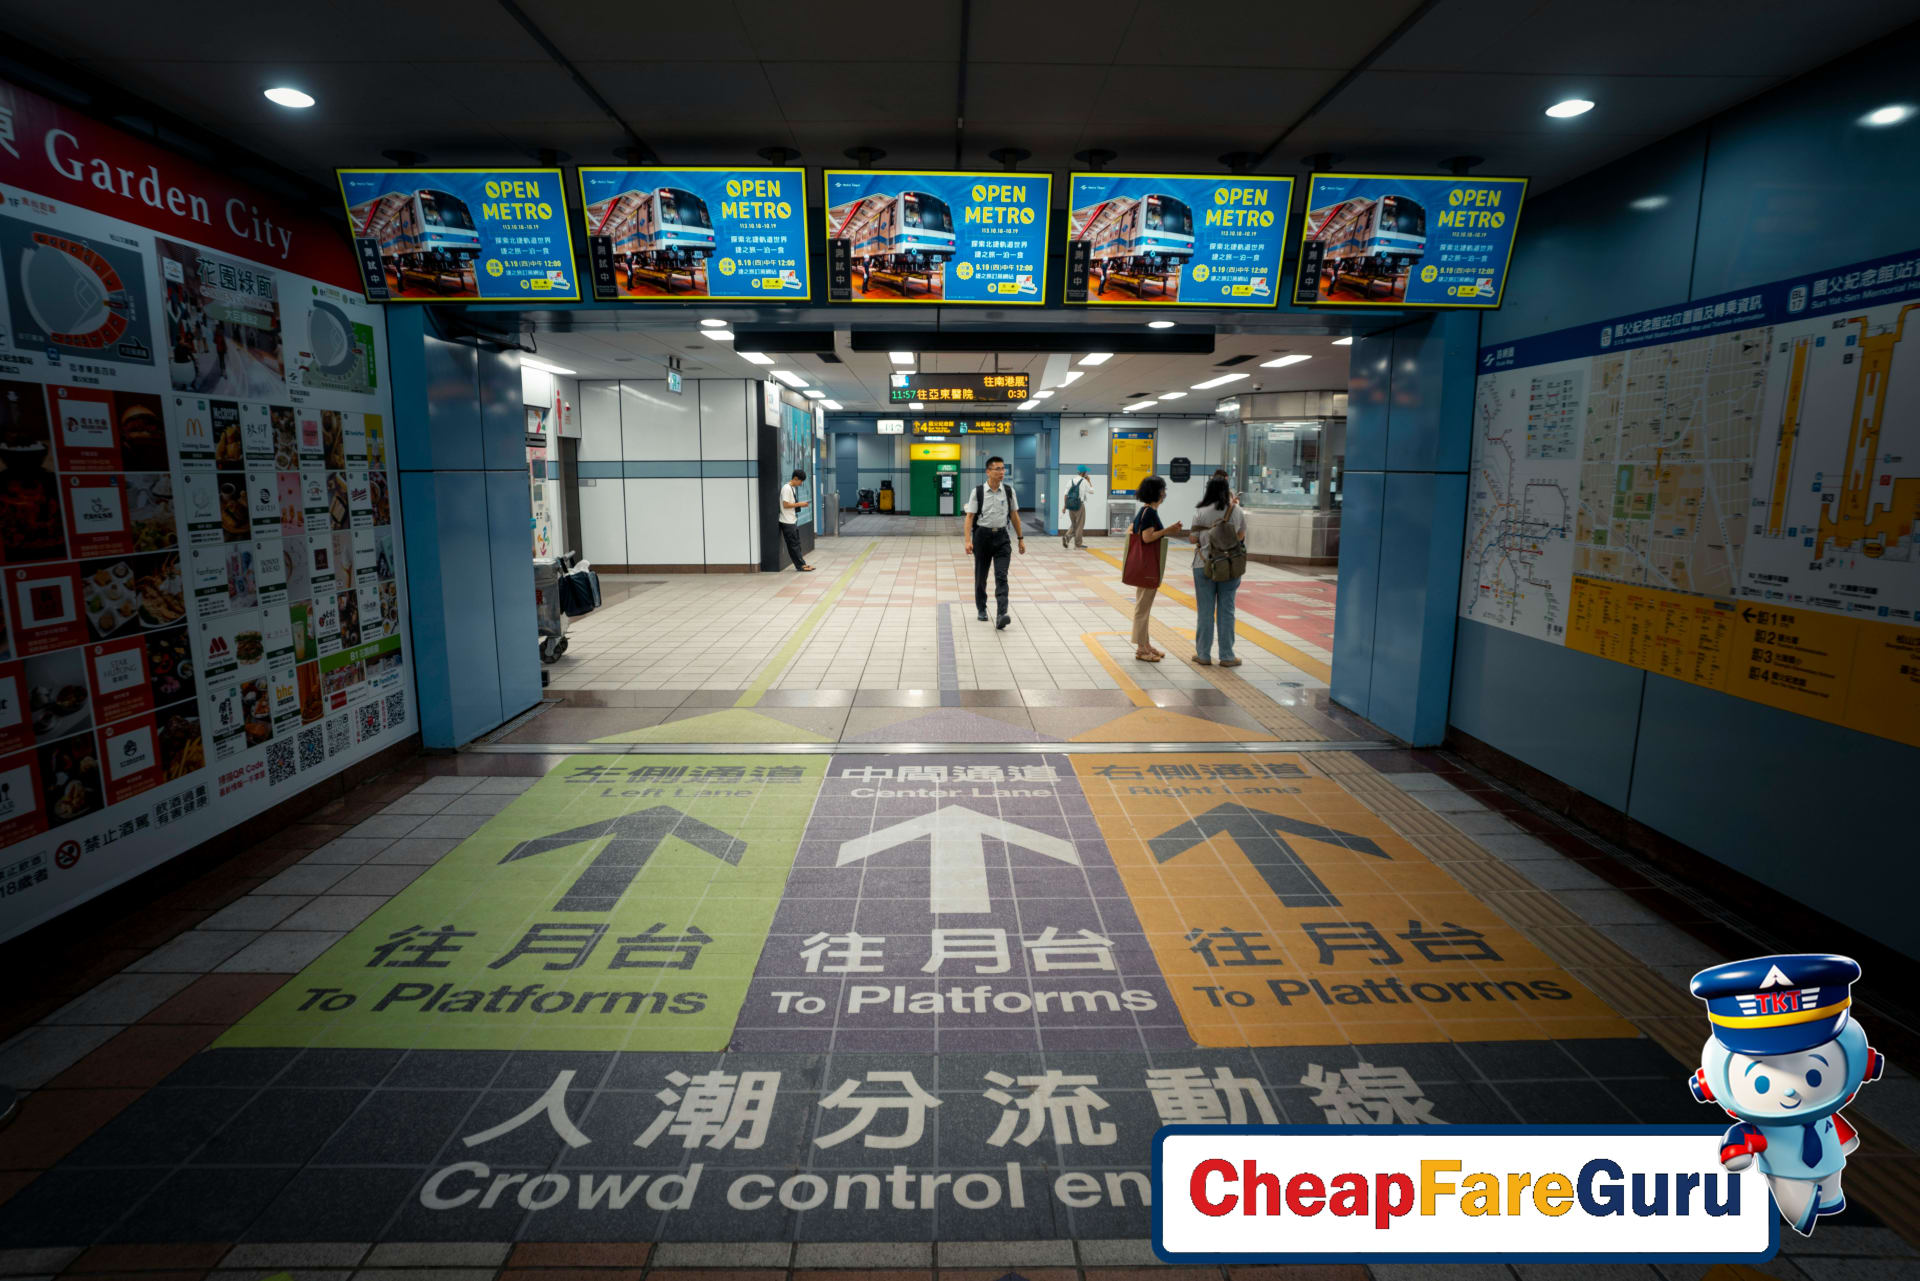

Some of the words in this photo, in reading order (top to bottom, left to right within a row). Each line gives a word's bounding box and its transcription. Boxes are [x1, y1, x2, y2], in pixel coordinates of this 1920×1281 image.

[44, 128, 213, 226] Garden
[225, 198, 293, 260] City
[485, 181, 540, 198] OPEN
[726, 180, 780, 197] OPEN
[972, 185, 1026, 203] OPEN
[1215, 188, 1268, 206] OPEN
[1448, 189, 1502, 207] OPEN
[482, 203, 552, 220] METRO
[721, 202, 792, 219] METRO
[965, 206, 1035, 224] METRO
[1205, 209, 1274, 227] METRO
[1437, 210, 1505, 228] METRO
[196, 258, 273, 300] 花園綠廊
[1811, 300, 1826, 309] Sun
[1862, 283, 1906, 299] Memorial
[984, 376, 1028, 388] 往南港展
[892, 390, 916, 399] 11:57
[917, 388, 974, 400] 往亞東醫院
[1008, 390, 1027, 399] 0:30
[920, 422, 928, 433] 4
[996, 422, 1004, 432] 3
[1771, 613, 1777, 625] 1
[1767, 632, 1776, 645] 2
[1764, 650, 1773, 664] 3
[1761, 669, 1769, 683] 4
[275, 685, 294, 700] bhc
[245, 761, 264, 773] Code
[564, 764, 808, 784] 左側通道
[841, 764, 1062, 785] 中間通道
[1092, 764, 1314, 784] 右側通道
[602, 787, 675, 798] Left
[686, 787, 753, 798] Lane
[850, 787, 961, 799] Center
[972, 787, 1055, 799] Lane
[1128, 786, 1219, 799] Right
[1230, 786, 1302, 798] Lane
[84, 813, 149, 853] 禁止酒駕
[365, 923, 713, 970] 往月台
[800, 927, 1117, 975] 往月台
[1190, 920, 1504, 968] 往月台
[297, 988, 356, 1012] To
[371, 983, 708, 1015] Platforms
[771, 991, 826, 1015] To
[847, 985, 1158, 1015] Platforms
[1192, 986, 1256, 1008] To
[1273, 977, 1574, 1009] Platforms
[463, 1062, 1451, 1151] 人潮分流動線
[418, 1162, 699, 1210] Crowd
[728, 1162, 1026, 1210] control
